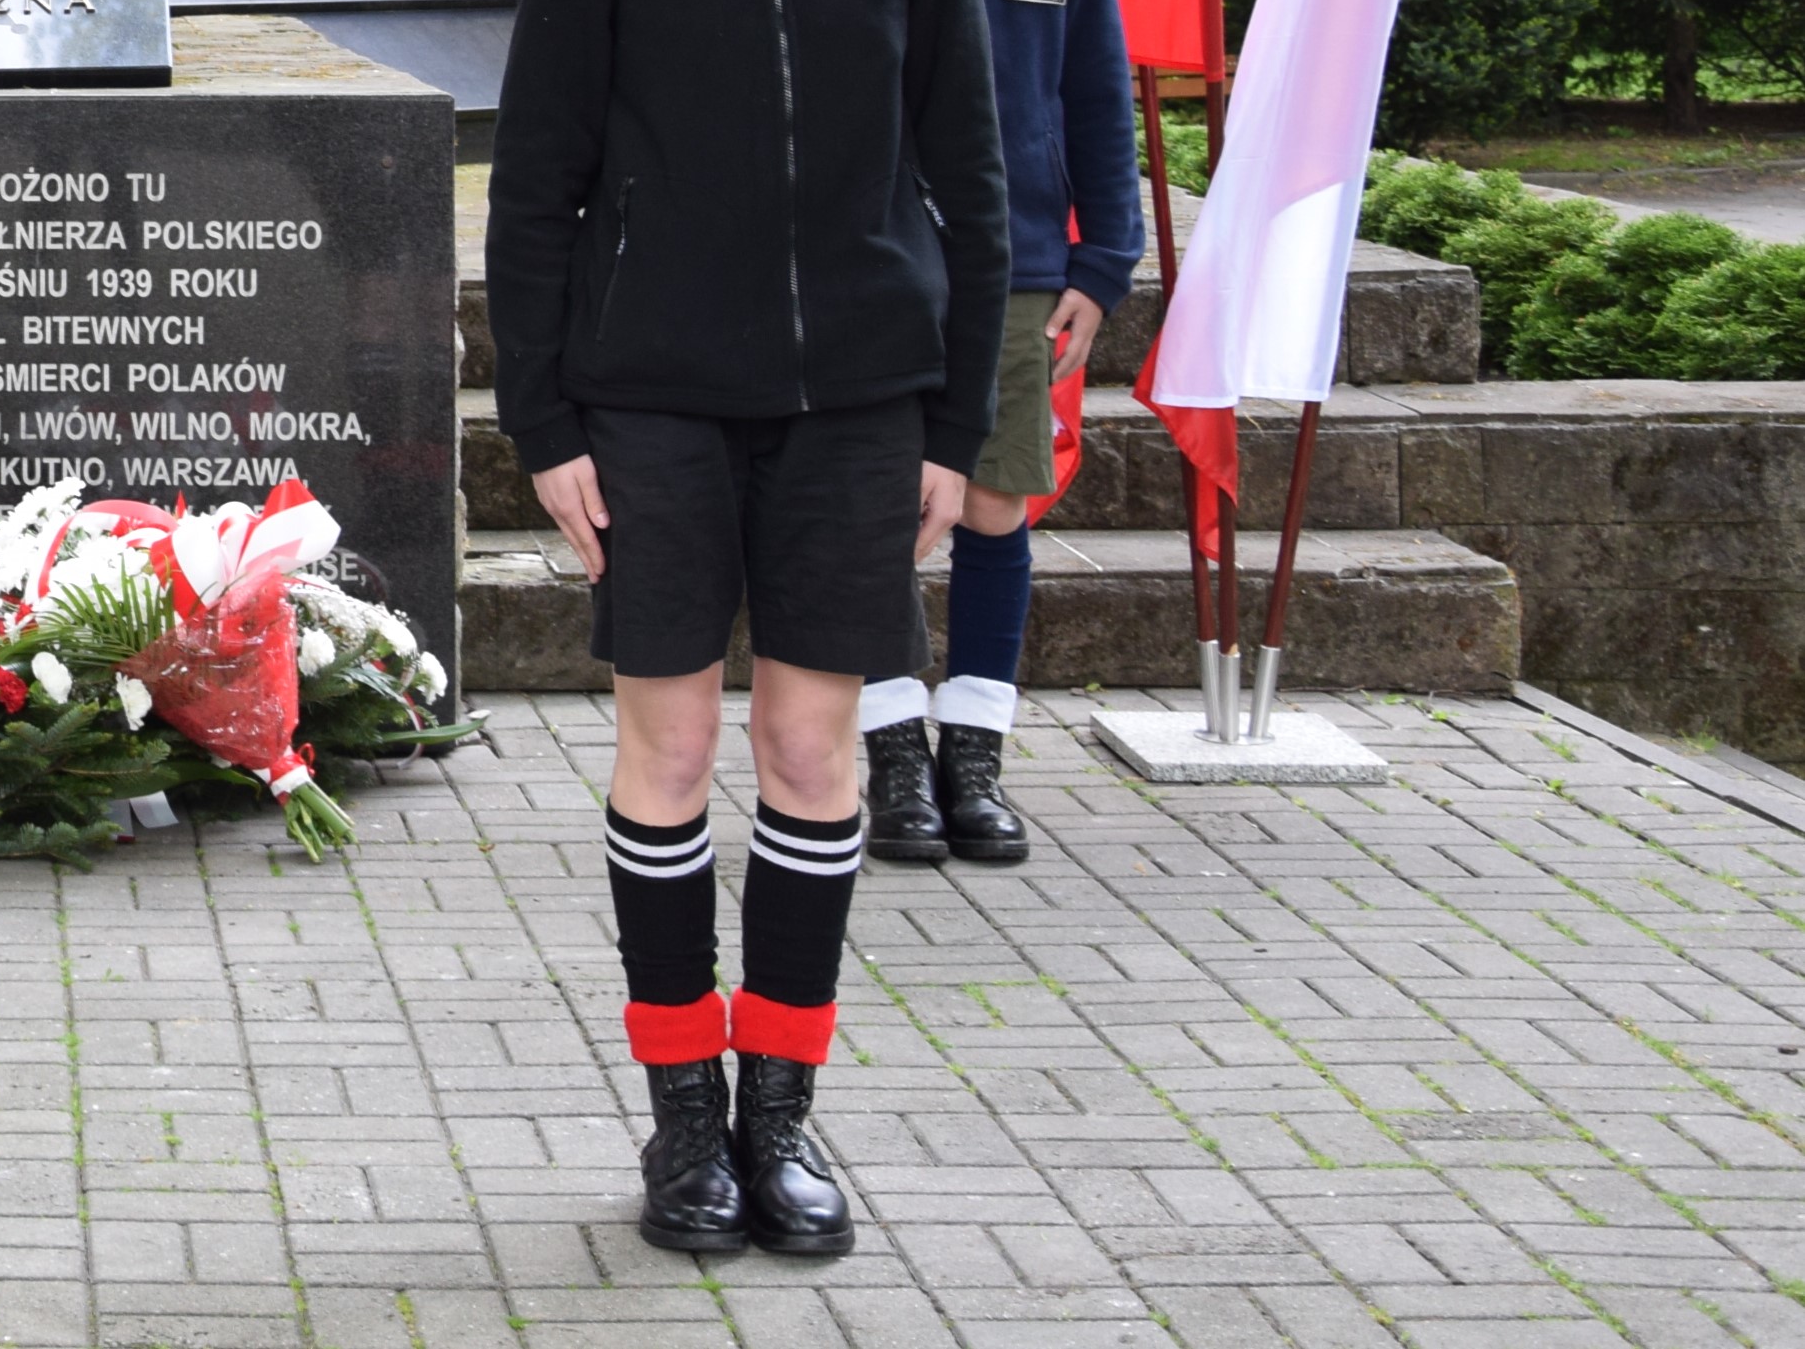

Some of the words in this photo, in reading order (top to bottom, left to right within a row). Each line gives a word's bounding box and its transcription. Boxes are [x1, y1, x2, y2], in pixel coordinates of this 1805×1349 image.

[125, 172, 166, 202] TU
[142, 220, 323, 251] POLSKIEGO
[86, 268, 153, 298] 1939
[170, 267, 258, 298] ROKU
[23, 315, 205, 346] BITEWNYCH
[128, 356, 287, 393] POLAKÓW
[19, 404, 122, 446] LWÓW,
[130, 411, 240, 446] WILNO,
[248, 410, 371, 446] MOKRA,
[0, 456, 113, 489] KUTNO,
